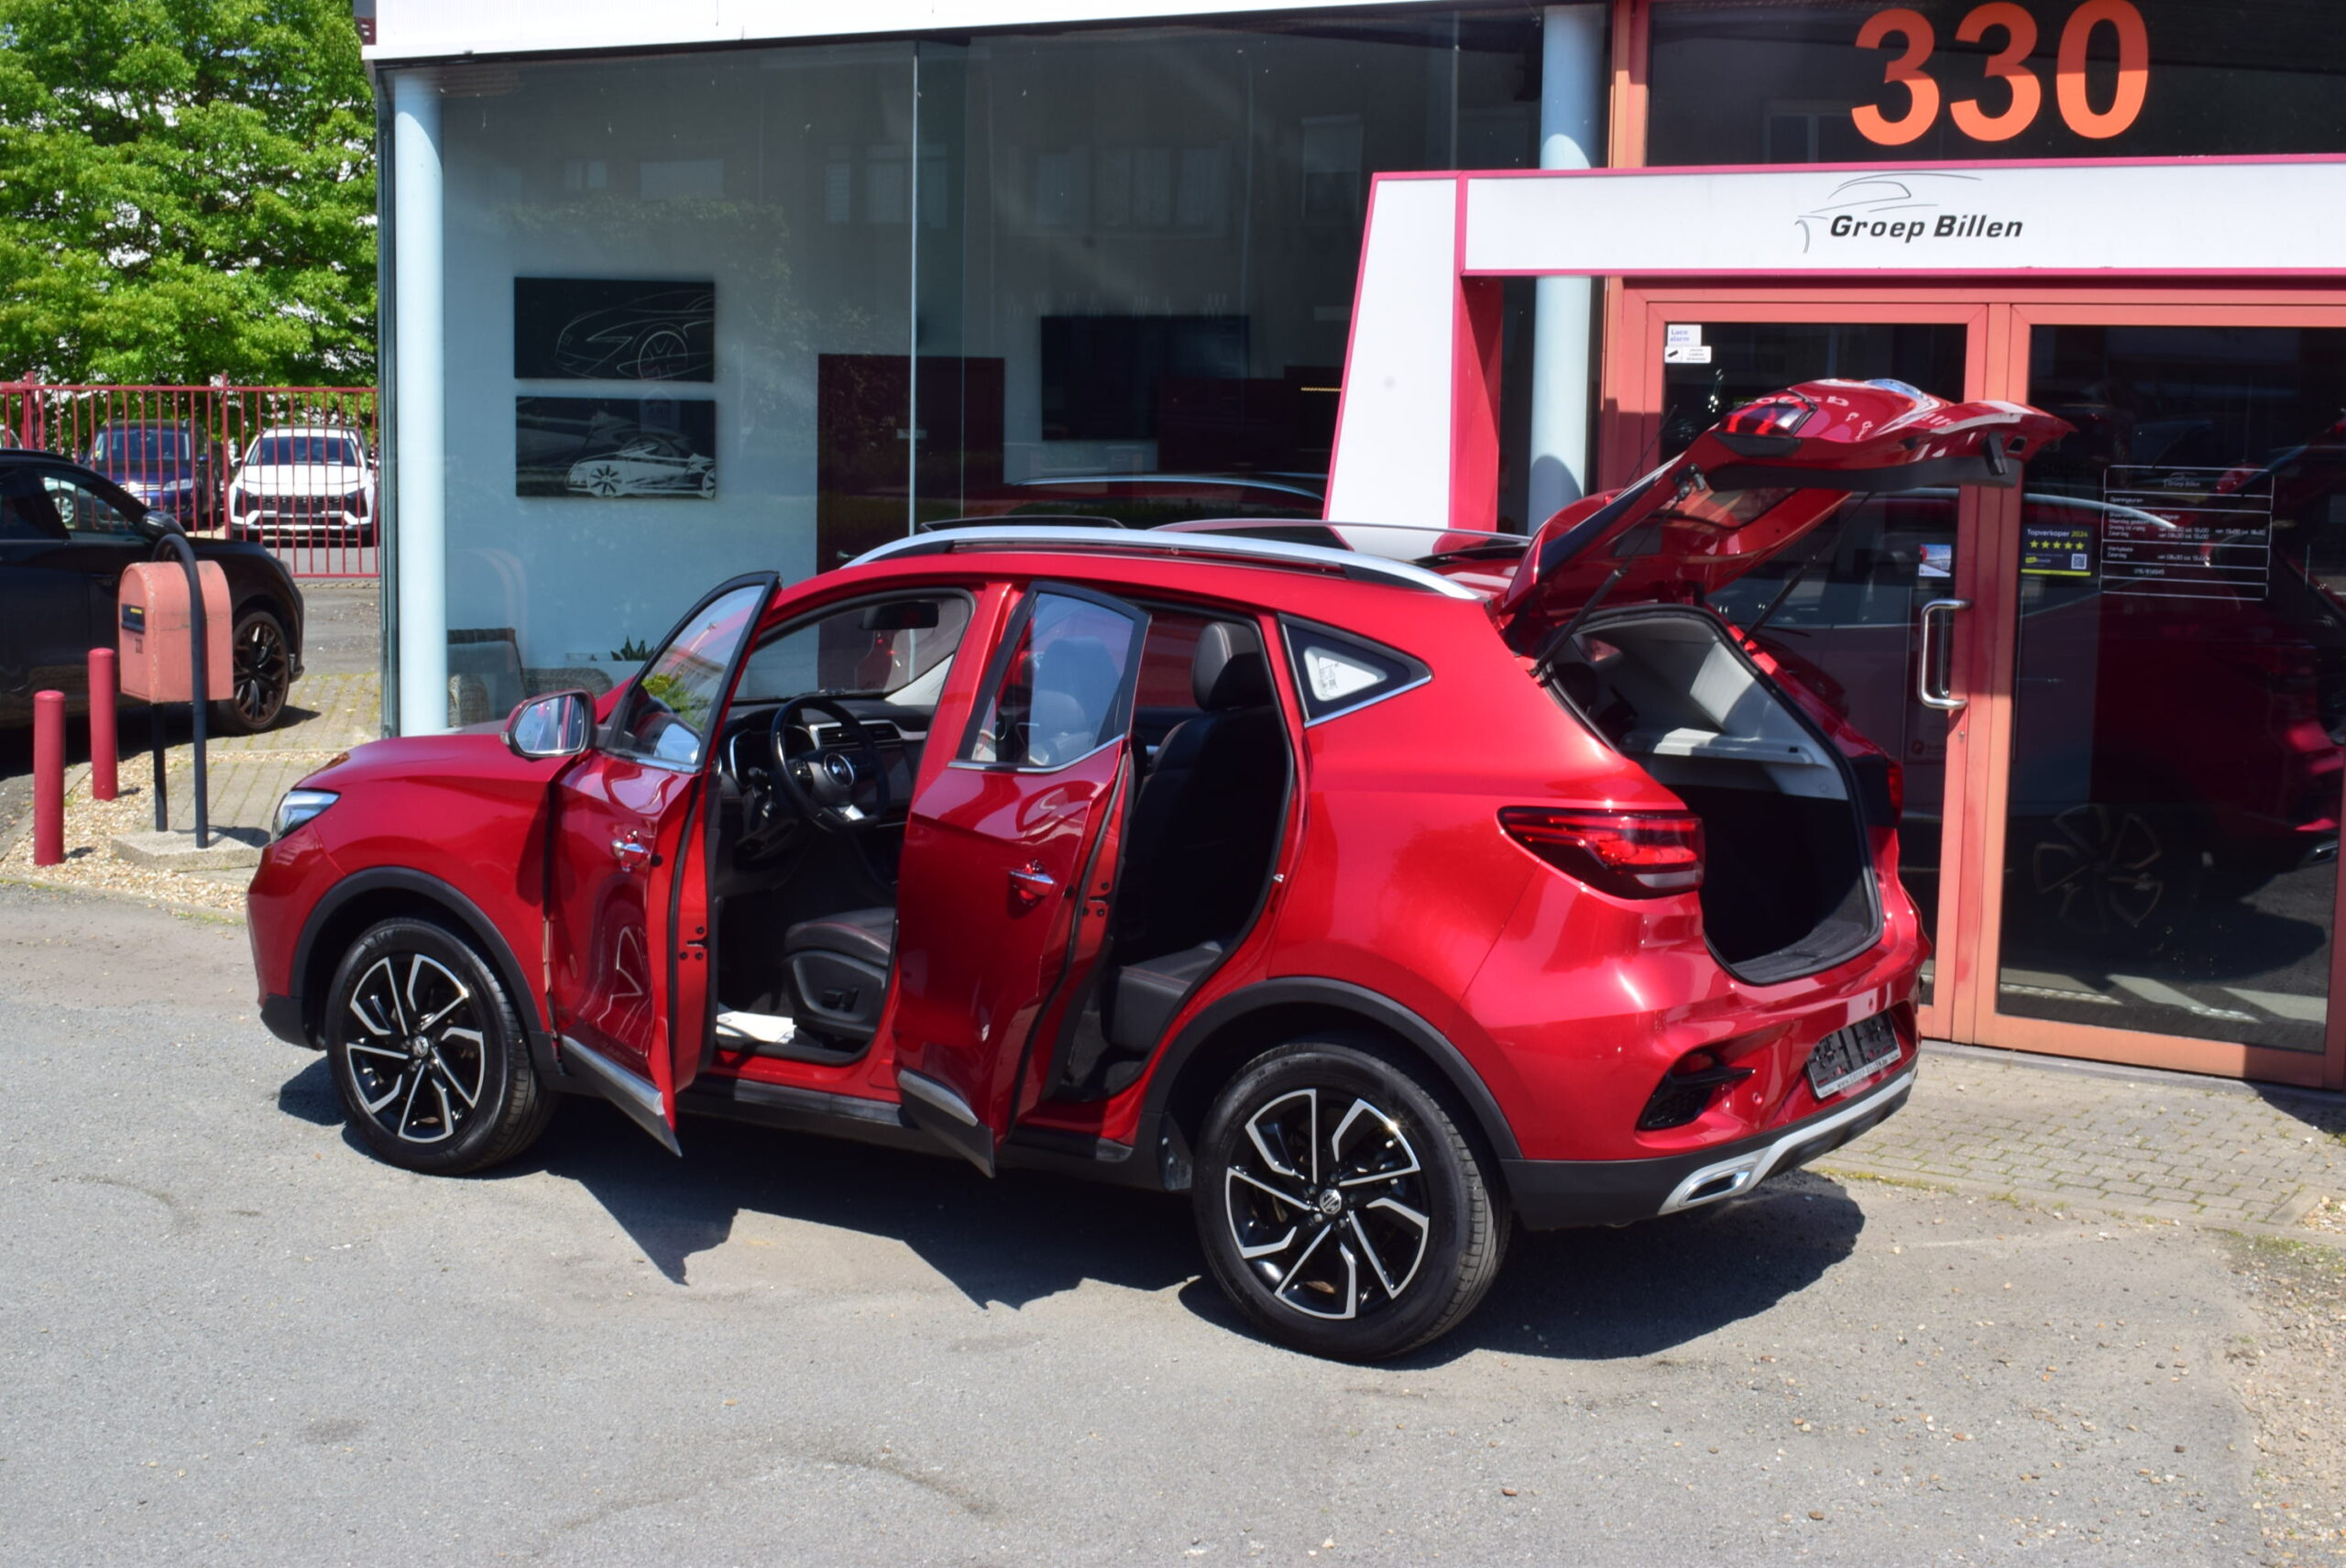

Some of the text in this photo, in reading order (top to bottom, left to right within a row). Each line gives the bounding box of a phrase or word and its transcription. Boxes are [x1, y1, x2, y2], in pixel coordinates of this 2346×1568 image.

[1851, 0, 2149, 146] 330
[1830, 214, 2023, 244] Groep Billen
[2027, 529, 2088, 538] Topverkoper 2024
